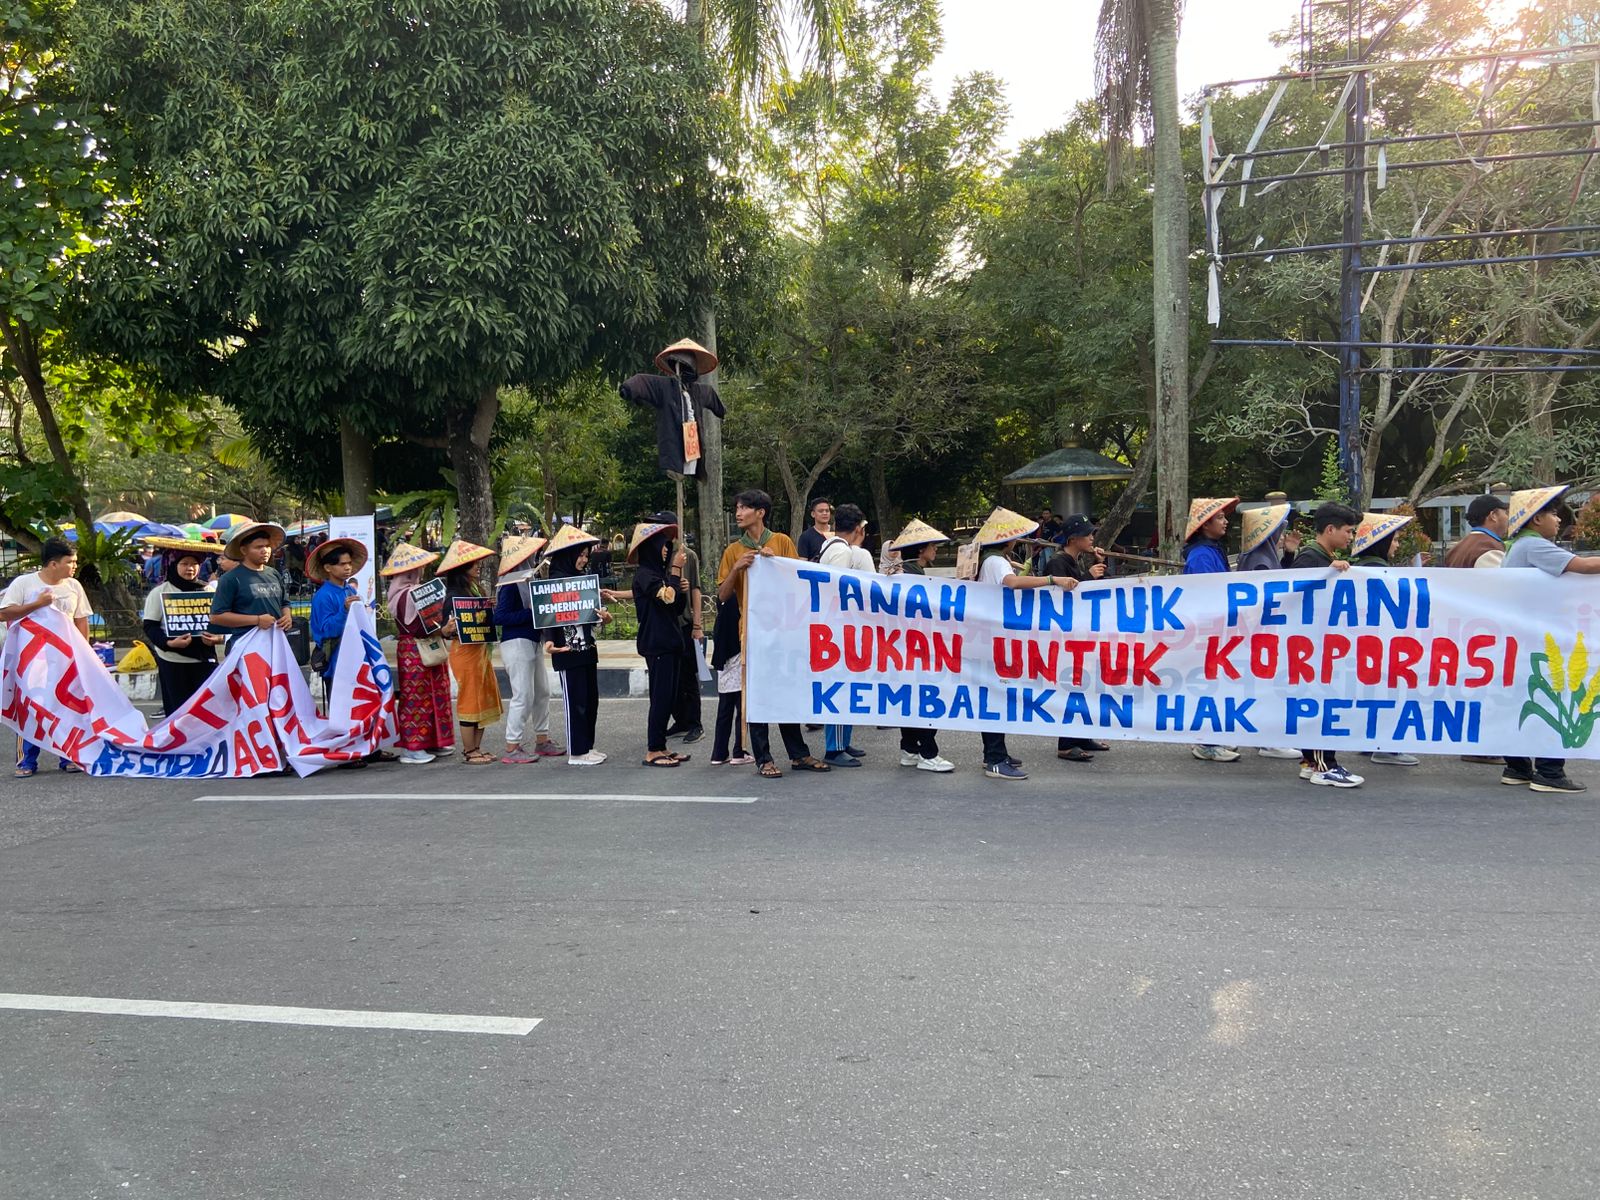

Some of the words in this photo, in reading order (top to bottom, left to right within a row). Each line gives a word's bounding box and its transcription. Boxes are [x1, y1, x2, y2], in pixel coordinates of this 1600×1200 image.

[532, 583, 564, 595] LAHAN
[565, 579, 597, 592] PETANI
[538, 599, 595, 614] PEMERINTAH
[797, 569, 966, 621] TANAH
[1002, 585, 1185, 633] UNTUK
[1227, 577, 1431, 629] PETANI
[168, 615, 195, 623] JAGA
[555, 611, 580, 623] EKSIS
[169, 623, 209, 631] ULAYAT
[809, 623, 963, 673] BUKAN
[993, 636, 1169, 687] UNTUK
[1204, 633, 1518, 688] KORPORASI
[812, 681, 1133, 728] KEMBALIKAN
[1156, 695, 1257, 733] HAK
[1285, 697, 1481, 743] PETANI
